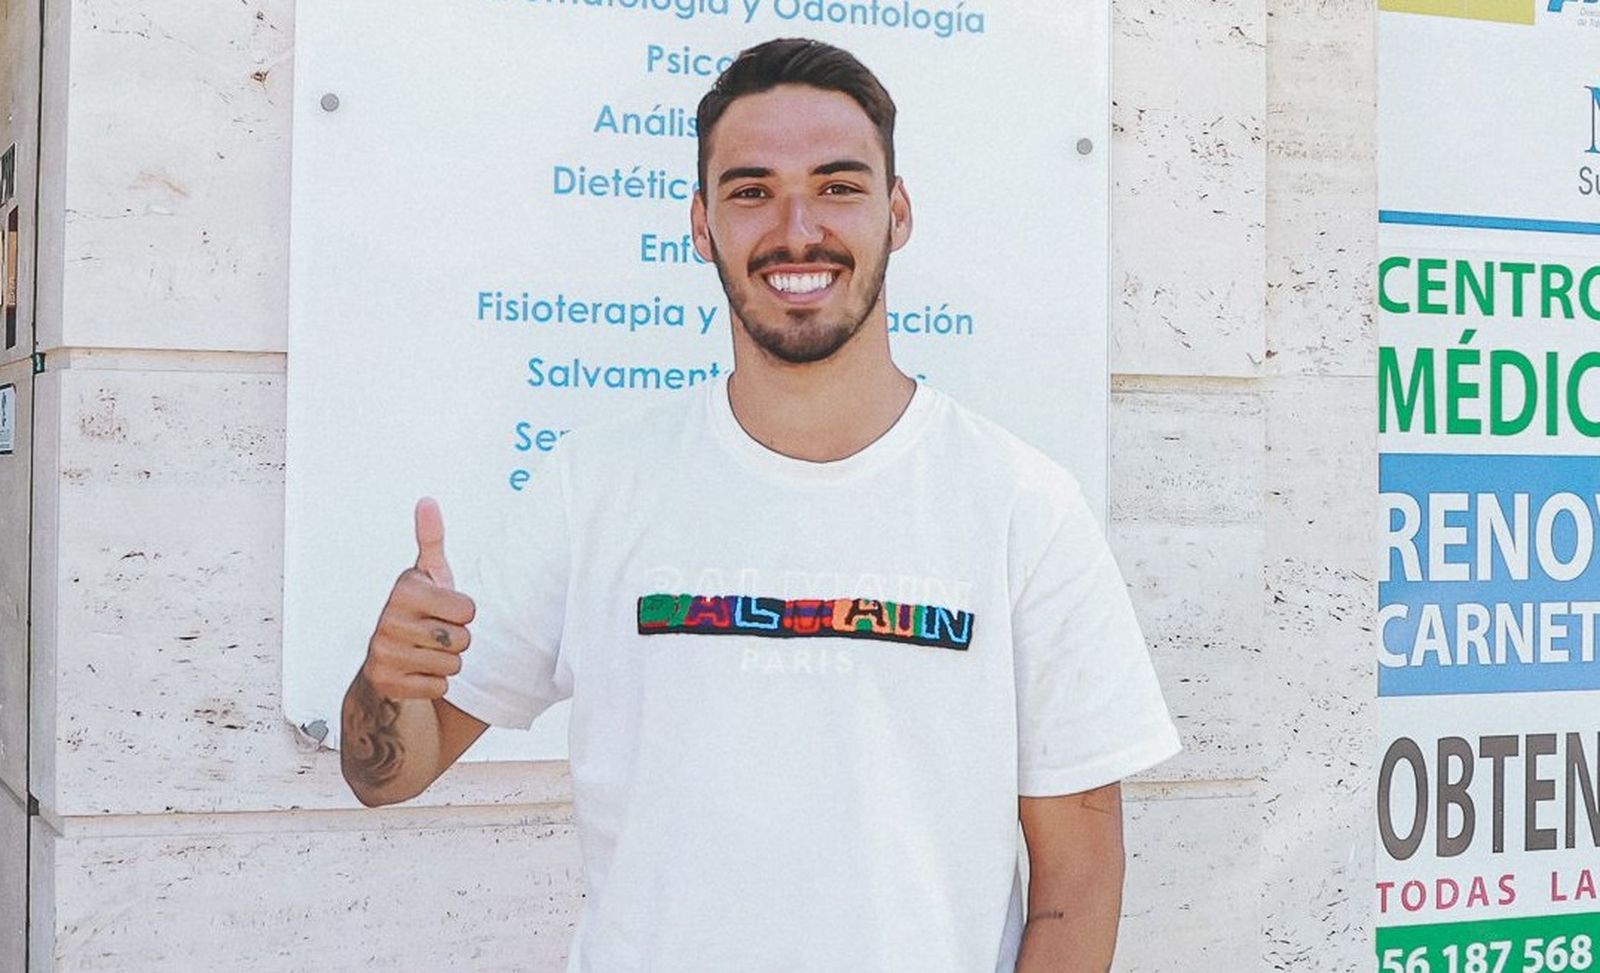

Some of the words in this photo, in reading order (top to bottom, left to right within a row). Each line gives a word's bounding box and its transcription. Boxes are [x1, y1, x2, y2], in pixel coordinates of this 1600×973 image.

[774, 0, 985, 38] Odontología
[1579, 166, 1600, 195] S
[477, 292, 685, 332] Fisioterapia
[698, 306, 717, 335] y
[1379, 492, 1600, 582] RENO
[637, 568, 975, 651] BALMAIN
[1379, 601, 1600, 668] CARNET
[741, 650, 855, 675] PARIS
[1377, 732, 1600, 861] OBTEN
[1376, 874, 1517, 913] TODAS
[1551, 869, 1597, 902] LA
[1376, 946, 1431, 973] 56
[1443, 940, 1513, 973] 187
[1523, 934, 1593, 973] 568
